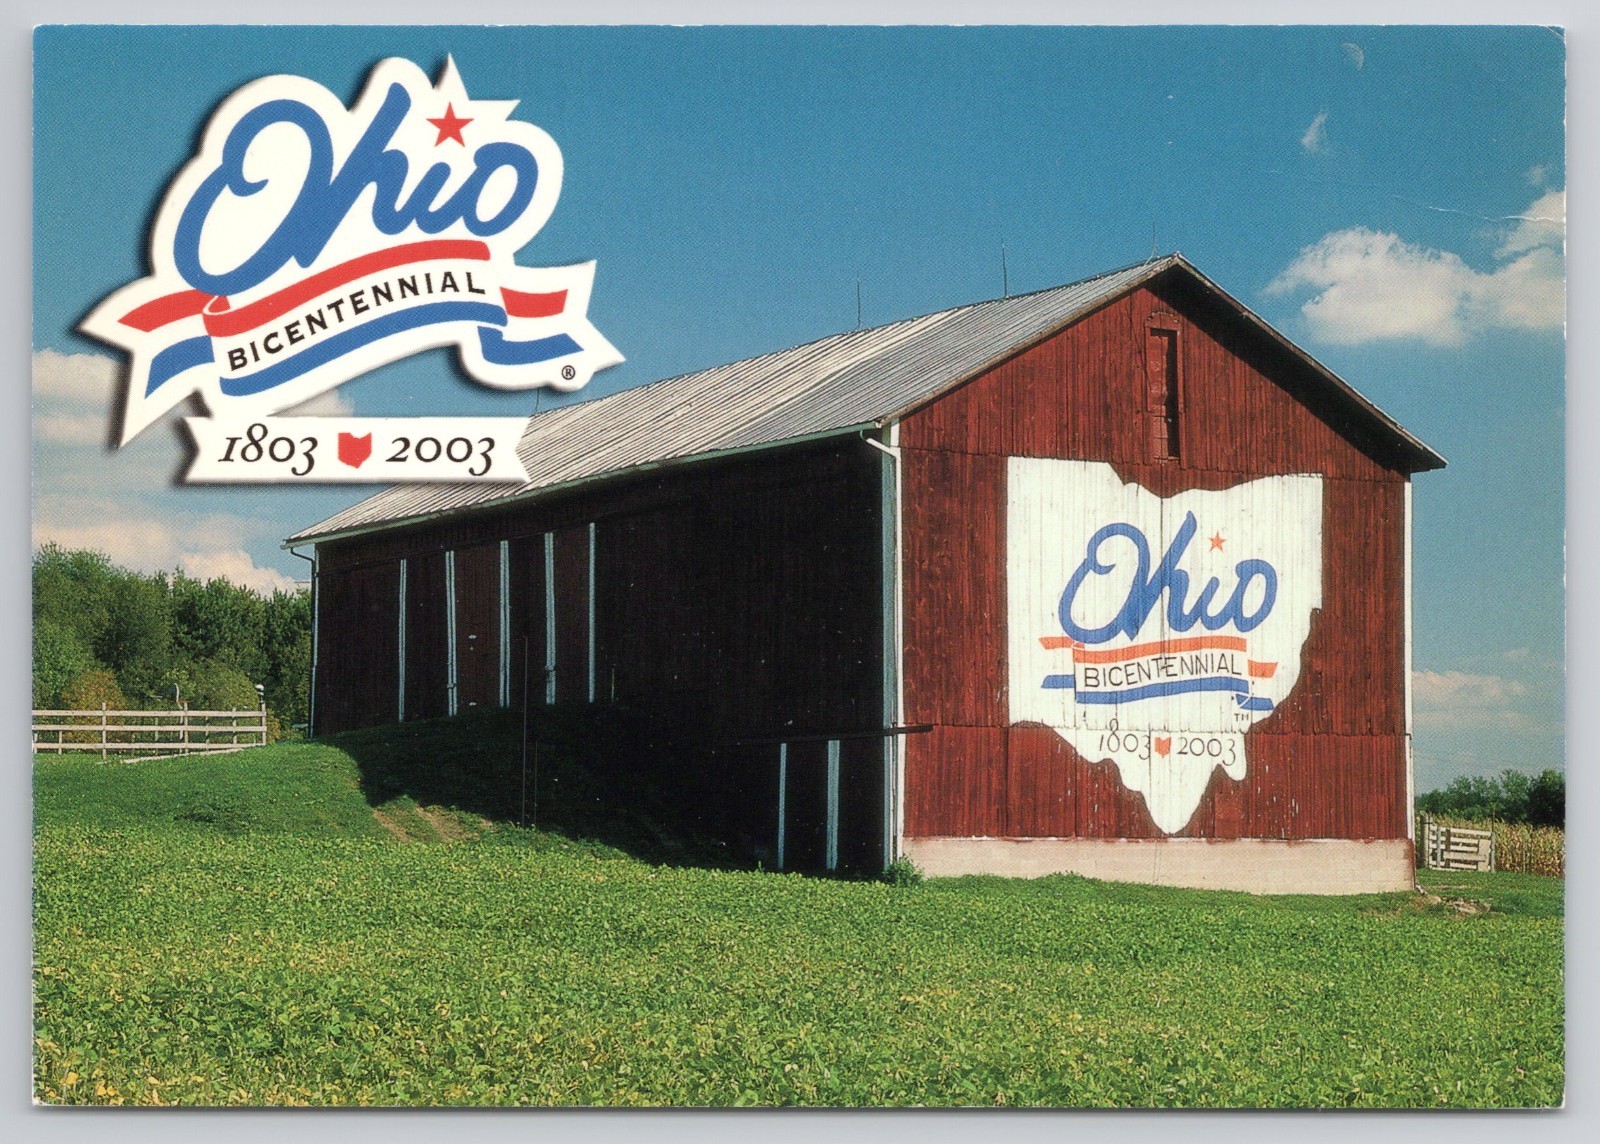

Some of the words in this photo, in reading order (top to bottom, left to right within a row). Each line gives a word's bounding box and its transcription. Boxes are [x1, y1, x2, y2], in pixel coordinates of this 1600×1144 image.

[1058, 511, 1278, 644] Ohio
[1084, 653, 1242, 688] BICENTENNIAL
[1099, 718, 1151, 760] 1803
[1178, 737, 1236, 765] 2003
